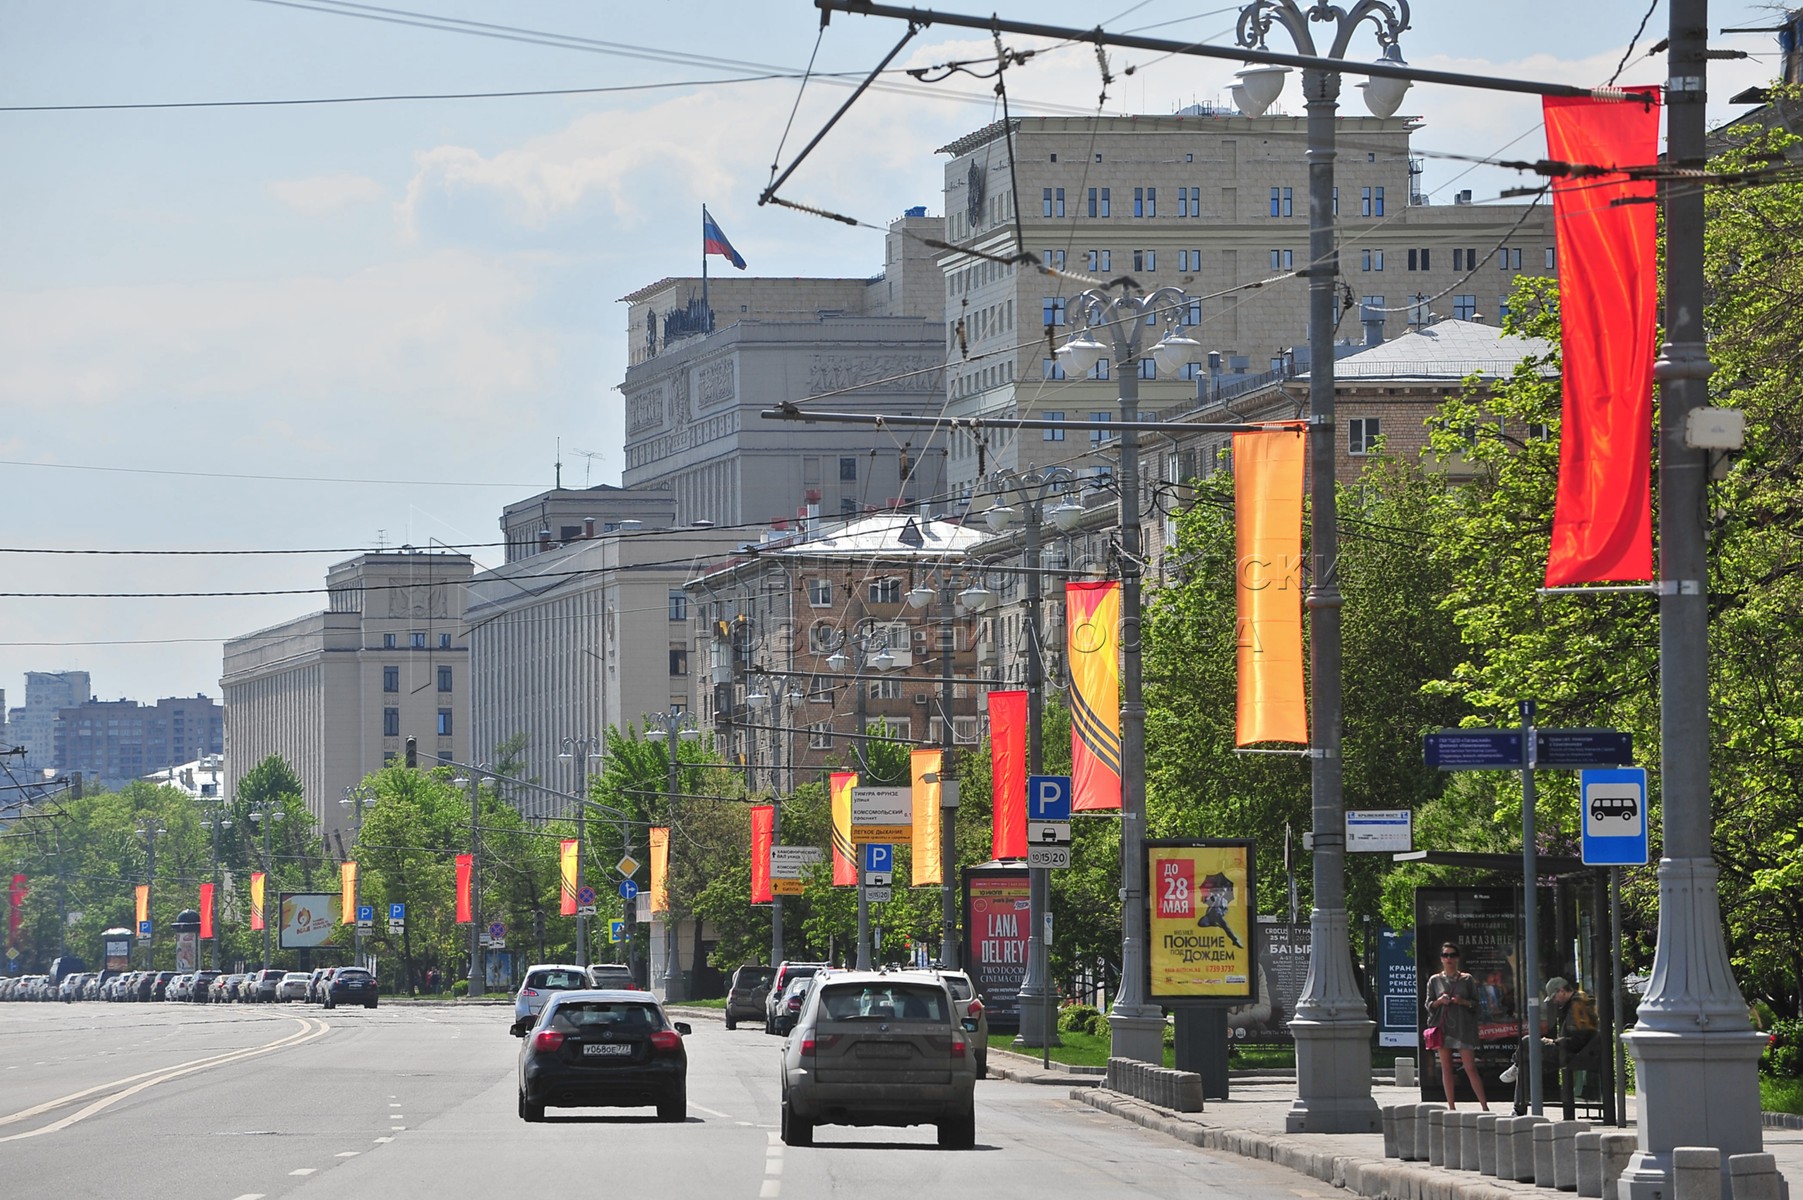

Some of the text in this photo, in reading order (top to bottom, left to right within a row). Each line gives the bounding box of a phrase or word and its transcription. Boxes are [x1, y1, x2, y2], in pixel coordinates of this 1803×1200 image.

[1040, 782, 1061, 813] P
[873, 847, 887, 868] P
[1042, 853, 1050, 861] 15
[1053, 853, 1065, 862] 20
[1164, 864, 1179, 877] ДО
[1164, 877, 1188, 900] 28
[361, 908, 370, 919] P
[393, 905, 402, 917] P
[1163, 901, 1188, 914] МАЯ
[988, 914, 1018, 937] LANA
[981, 940, 1025, 963] DEL REY
[983, 966, 1024, 975] TWO DOOR
[980, 975, 1024, 983] CINEMA CLU
